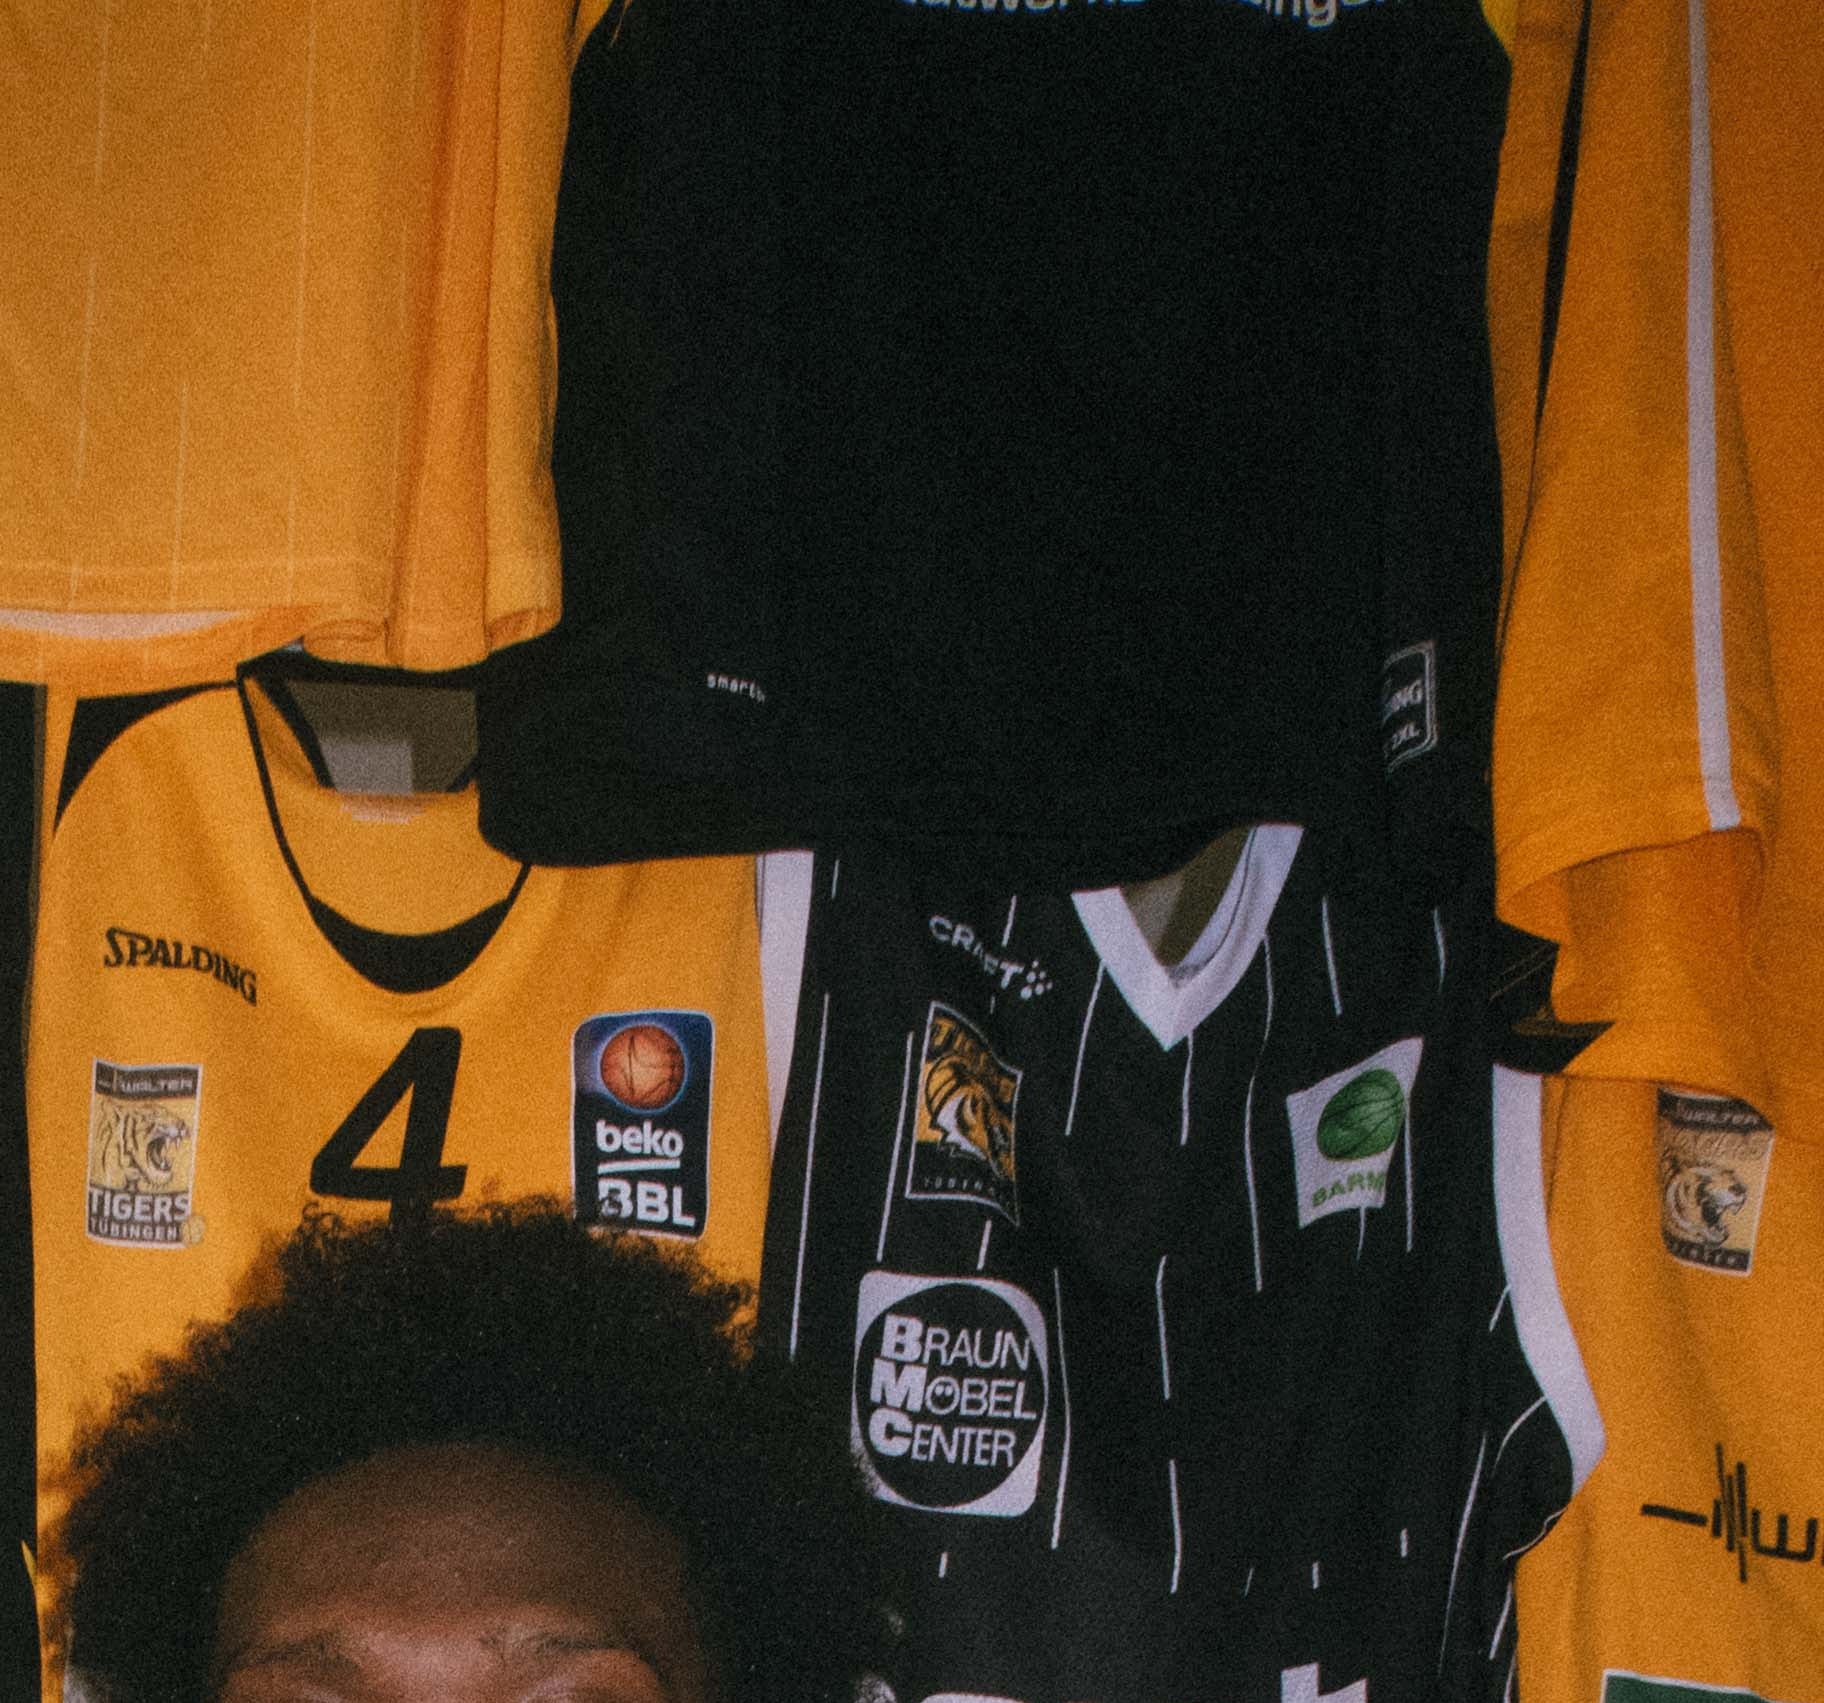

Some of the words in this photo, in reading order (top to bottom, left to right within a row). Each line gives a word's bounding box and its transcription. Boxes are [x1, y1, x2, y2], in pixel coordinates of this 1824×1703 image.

[104, 927, 257, 1006] SPALDING
[309, 1027, 468, 1222] 4
[595, 1120, 684, 1158] beko
[89, 1186, 189, 1221] TIGERS
[597, 1178, 696, 1227] BBL
[883, 1314, 1030, 1370] BRAUN
[868, 1406, 1017, 1467] CENTER
